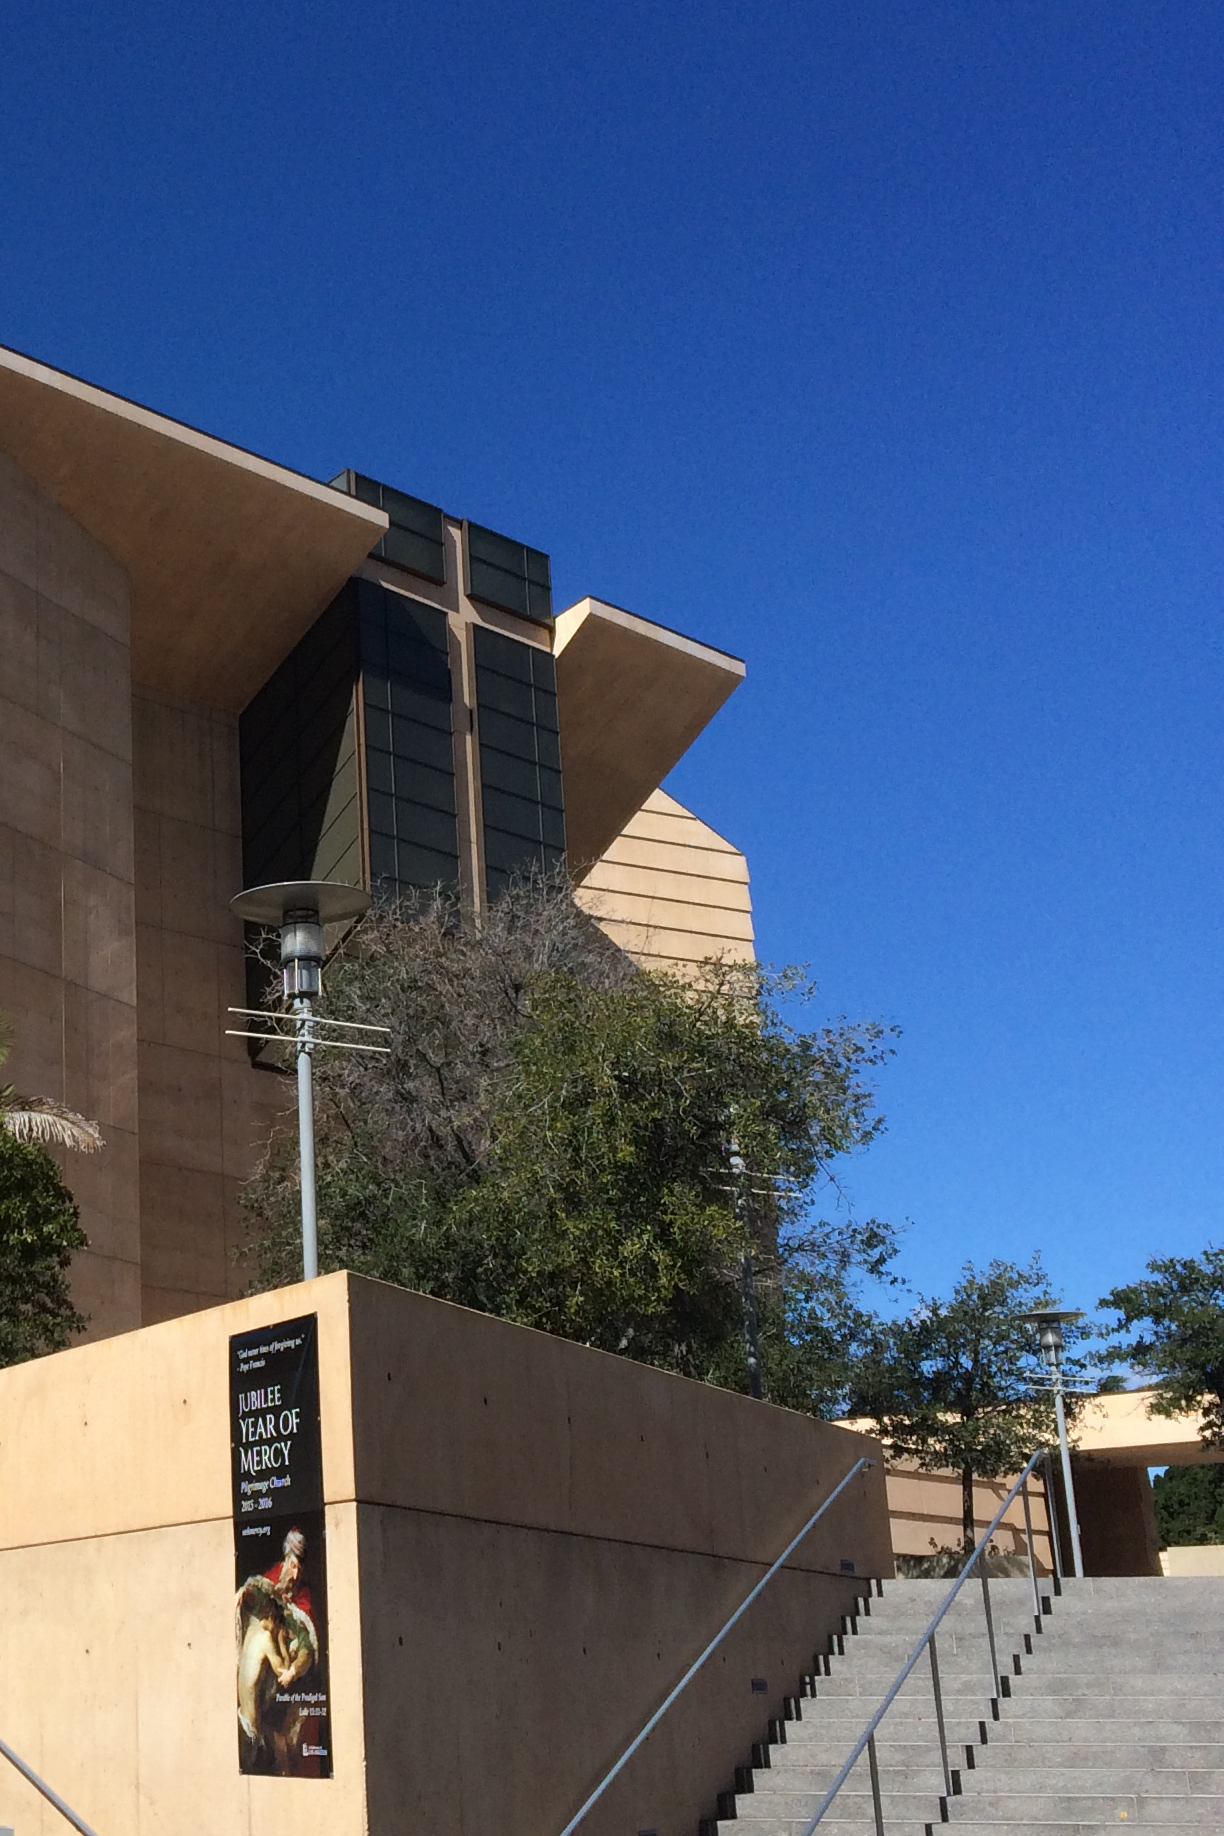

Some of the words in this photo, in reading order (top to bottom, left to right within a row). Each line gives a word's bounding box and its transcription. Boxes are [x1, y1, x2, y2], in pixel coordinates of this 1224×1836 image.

[238, 1385, 282, 1417] JUBILEE
[239, 1413, 277, 1443] YEAR
[279, 1408, 300, 1435] OF
[239, 1441, 292, 1476] MERCY
[240, 1480, 269, 1496] Pilgrimage
[269, 1474, 291, 1489] Church
[241, 1499, 254, 1512] 2015
[258, 1496, 273, 1510] 2016
